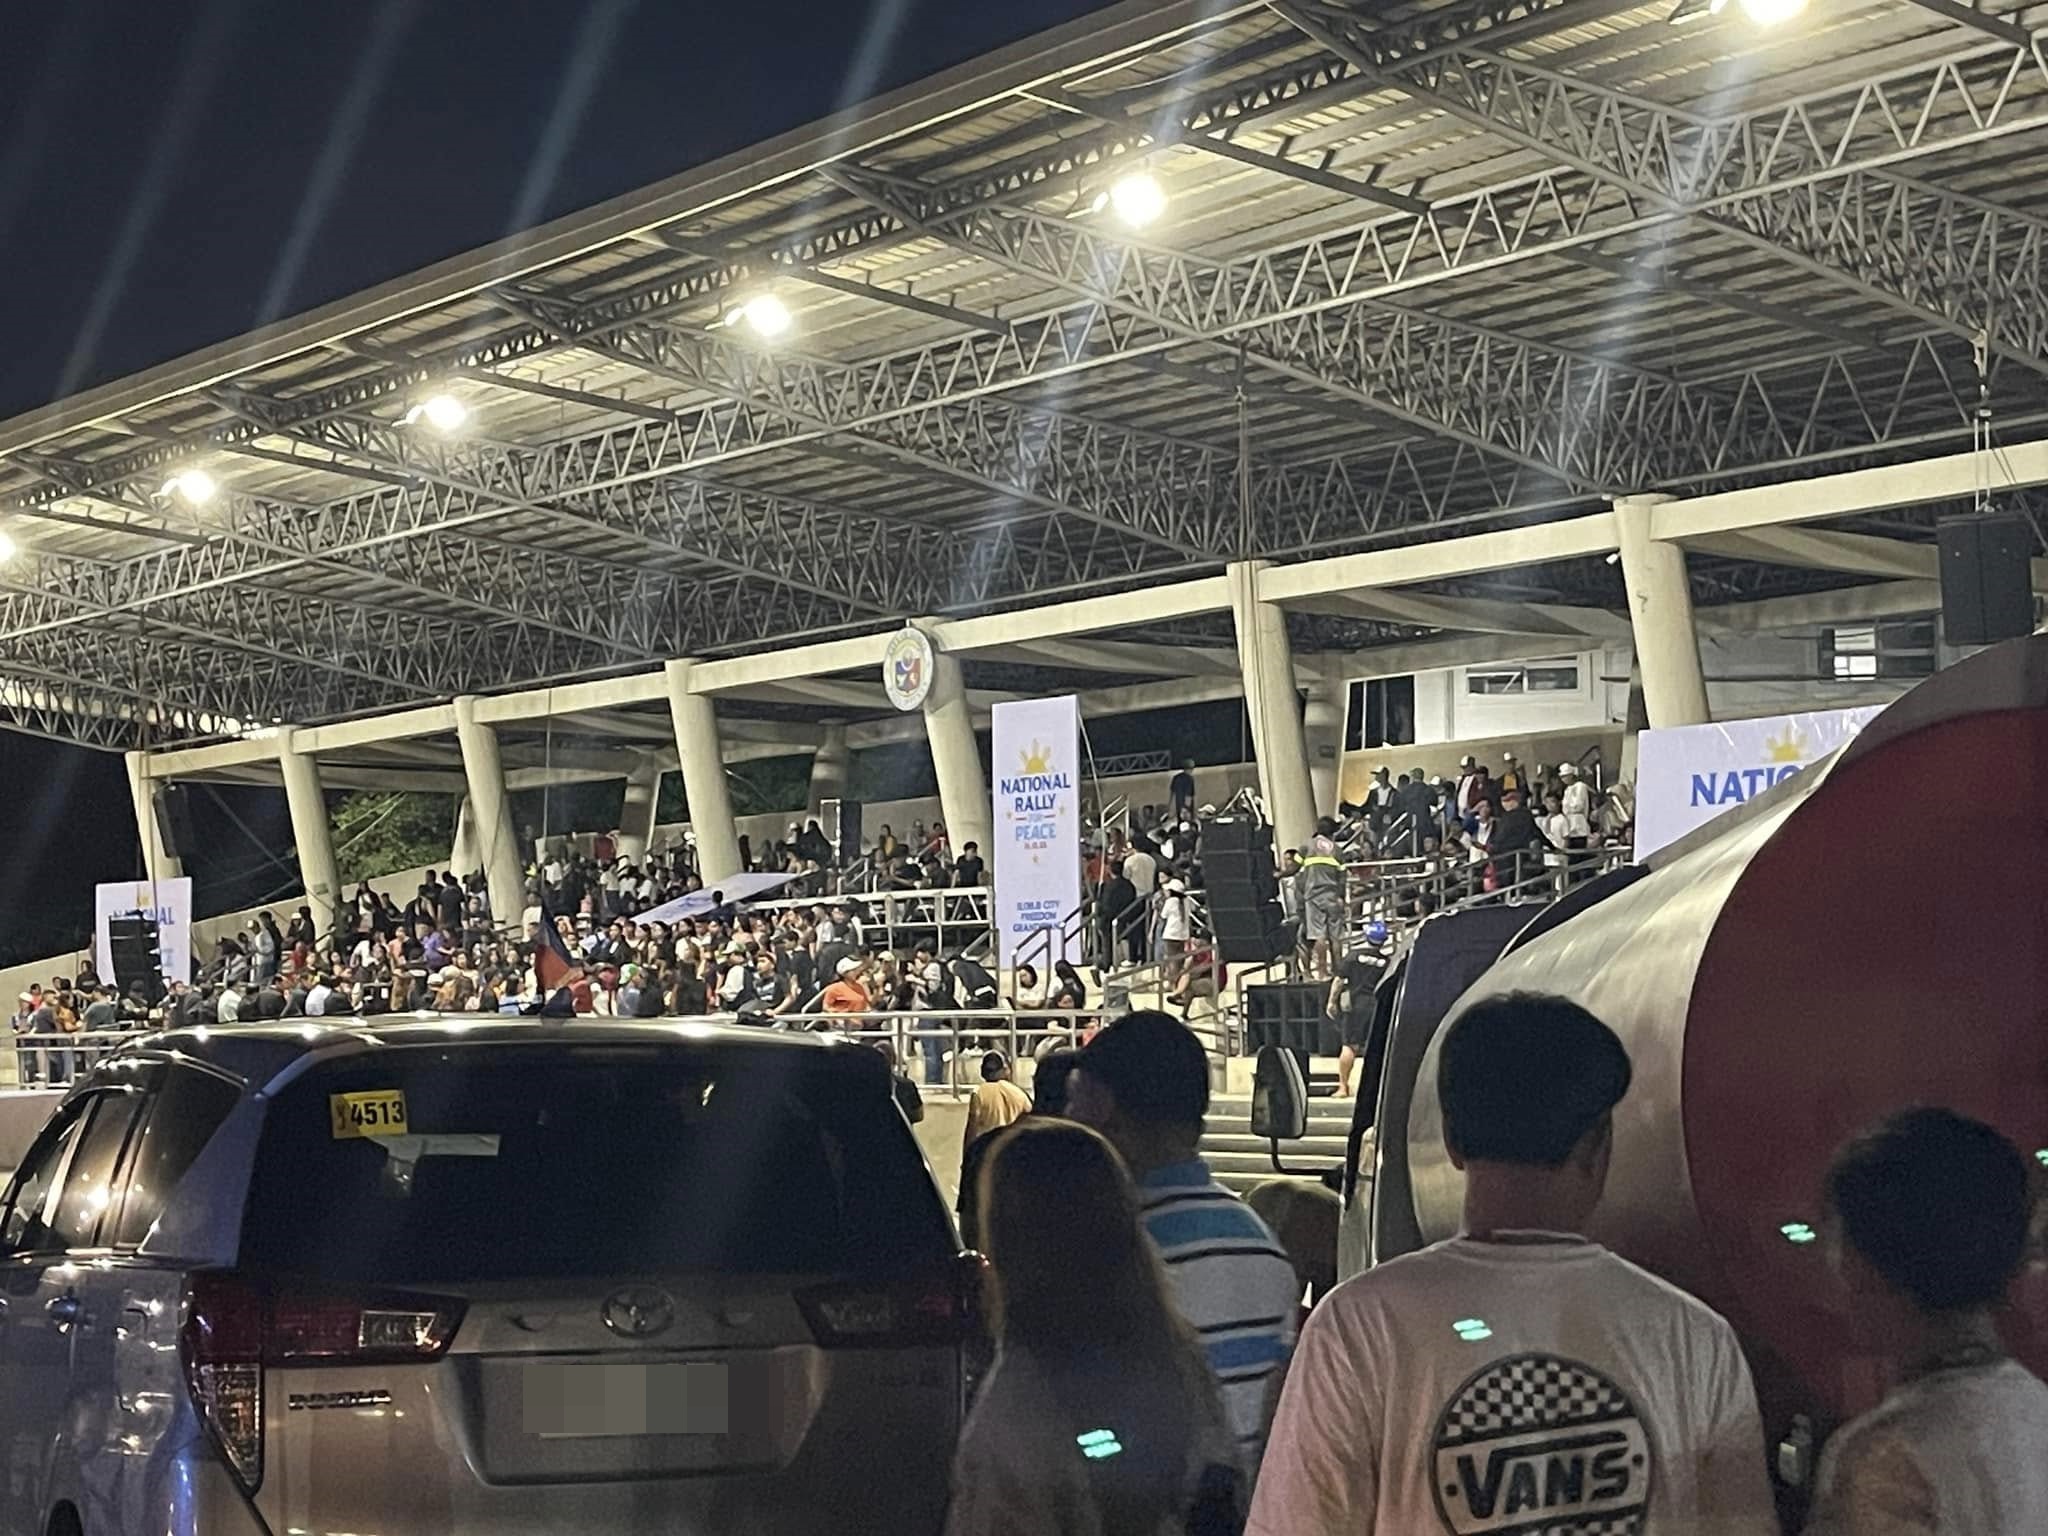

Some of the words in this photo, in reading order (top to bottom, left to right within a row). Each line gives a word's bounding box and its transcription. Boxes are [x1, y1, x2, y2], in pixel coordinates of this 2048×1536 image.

[1001, 773, 1071, 795] NATIONAL
[1015, 793, 1057, 812] RALLY
[1015, 823, 1057, 841] PEACE
[351, 1101, 404, 1126] 4513
[1457, 1430, 1630, 1519] VANS
